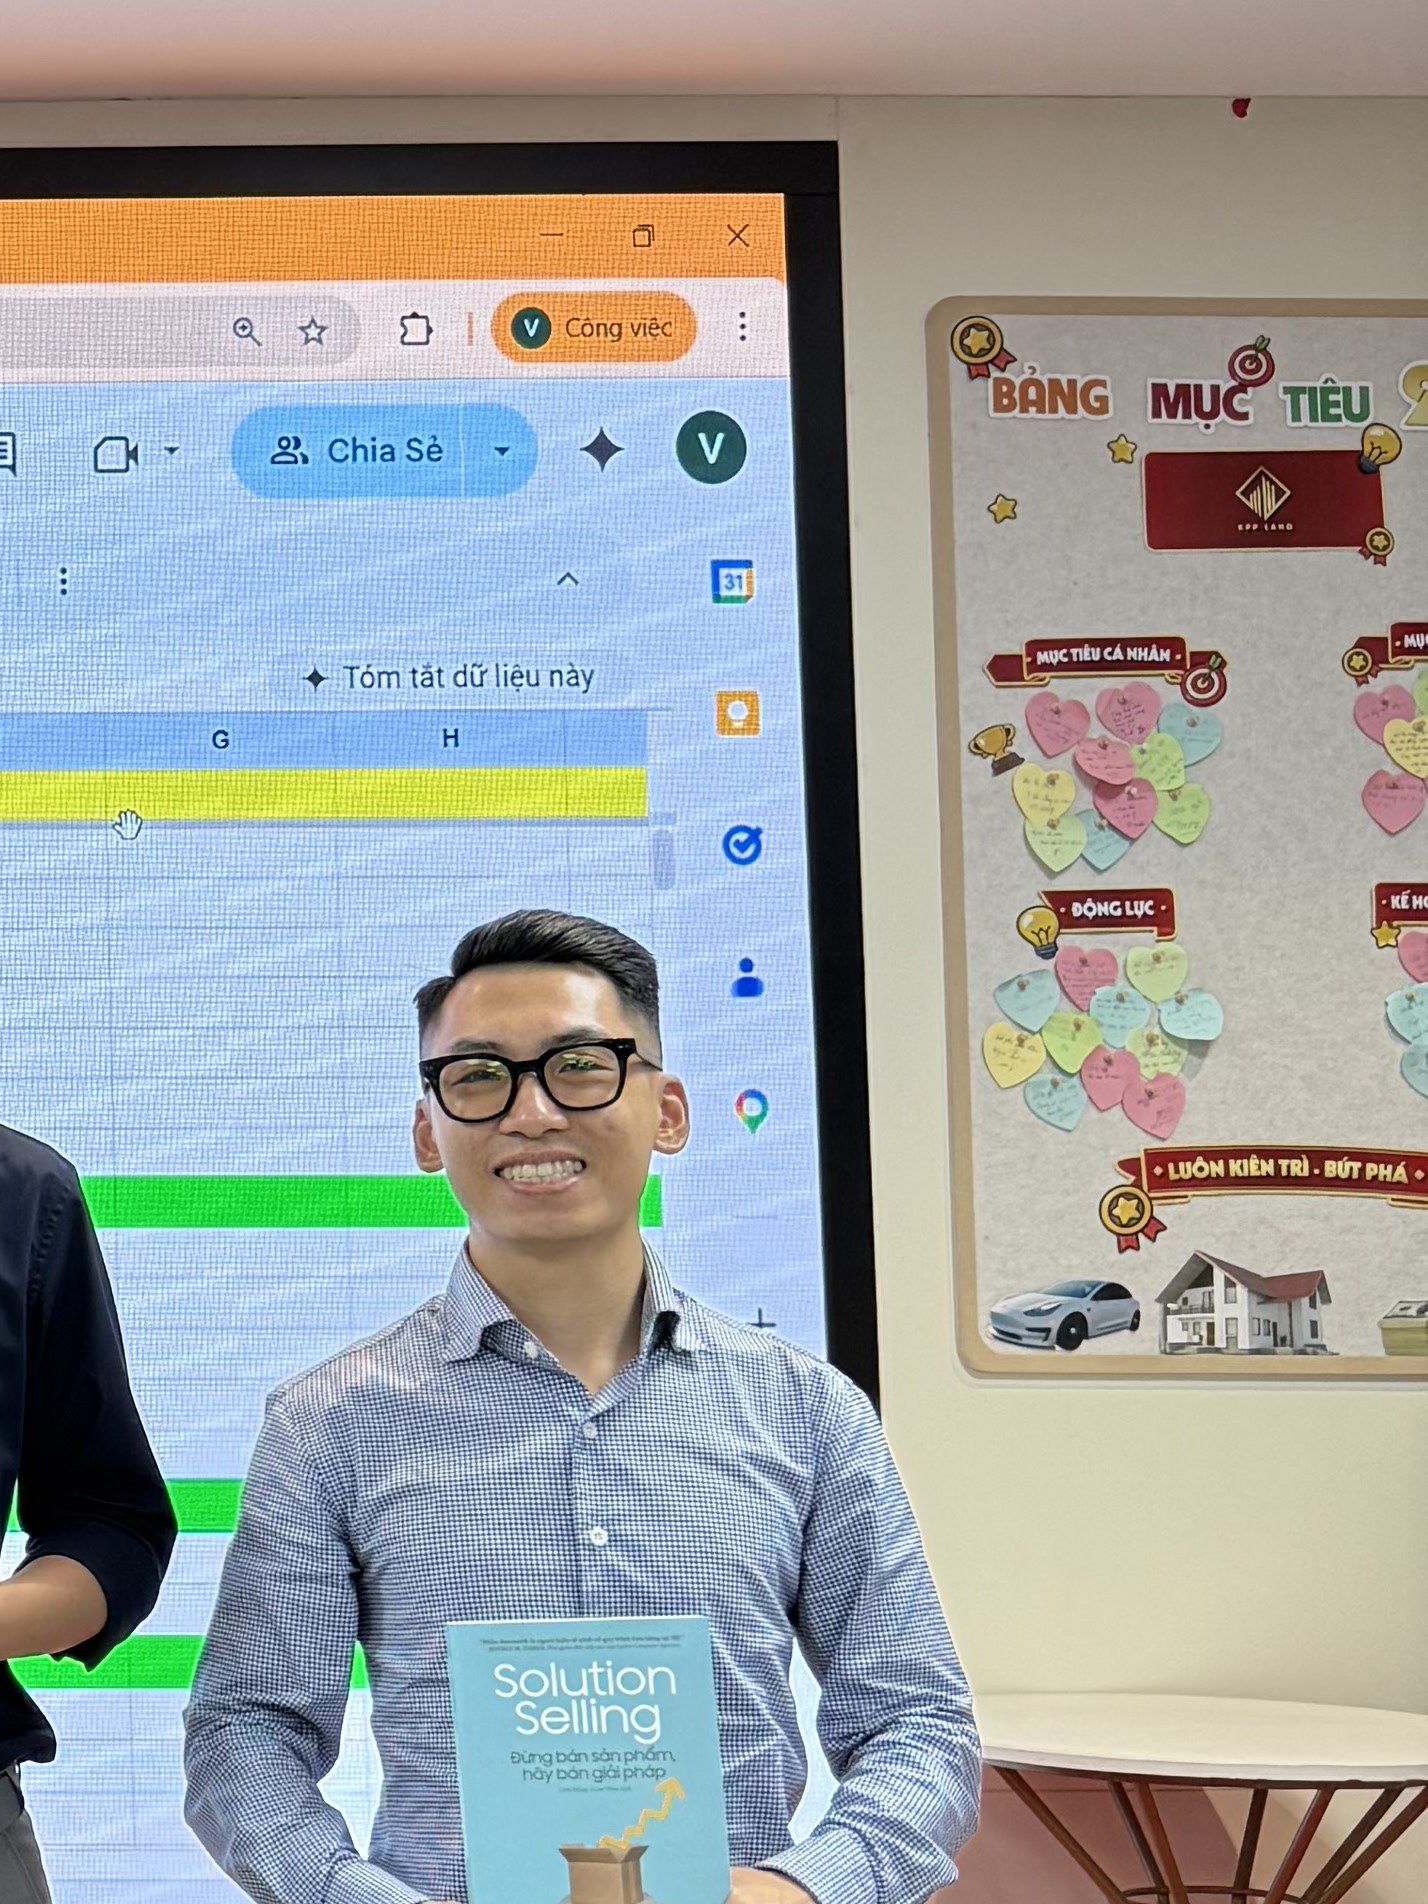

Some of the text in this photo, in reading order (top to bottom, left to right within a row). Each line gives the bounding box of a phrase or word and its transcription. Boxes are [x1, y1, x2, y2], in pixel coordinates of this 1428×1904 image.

[565, 316, 672, 343] Công việc
[992, 364, 1111, 416] BẢNG
[1150, 381, 1250, 432] MỤC
[1282, 377, 1371, 423] TIÊU
[328, 435, 442, 464] Chia Sẻ
[697, 433, 724, 464] V
[1037, 643, 1170, 666] MỤC TIÊU CÁ NHÂN
[344, 663, 594, 694] Tóm tắt dữ liệu này
[1071, 898, 1122, 920] ĐỘNG
[1390, 890, 1410, 909] KẾ
[1168, 1154, 1408, 1184] LUÔN KIÊN TRÌ BÚT PHÁ
[494, 1660, 676, 1698] Solution
[515, 1698, 661, 1745] Selling
[556, 1748, 588, 1763] bán
[557, 1765, 589, 1780] bán
[624, 1764, 666, 1782] pháp
